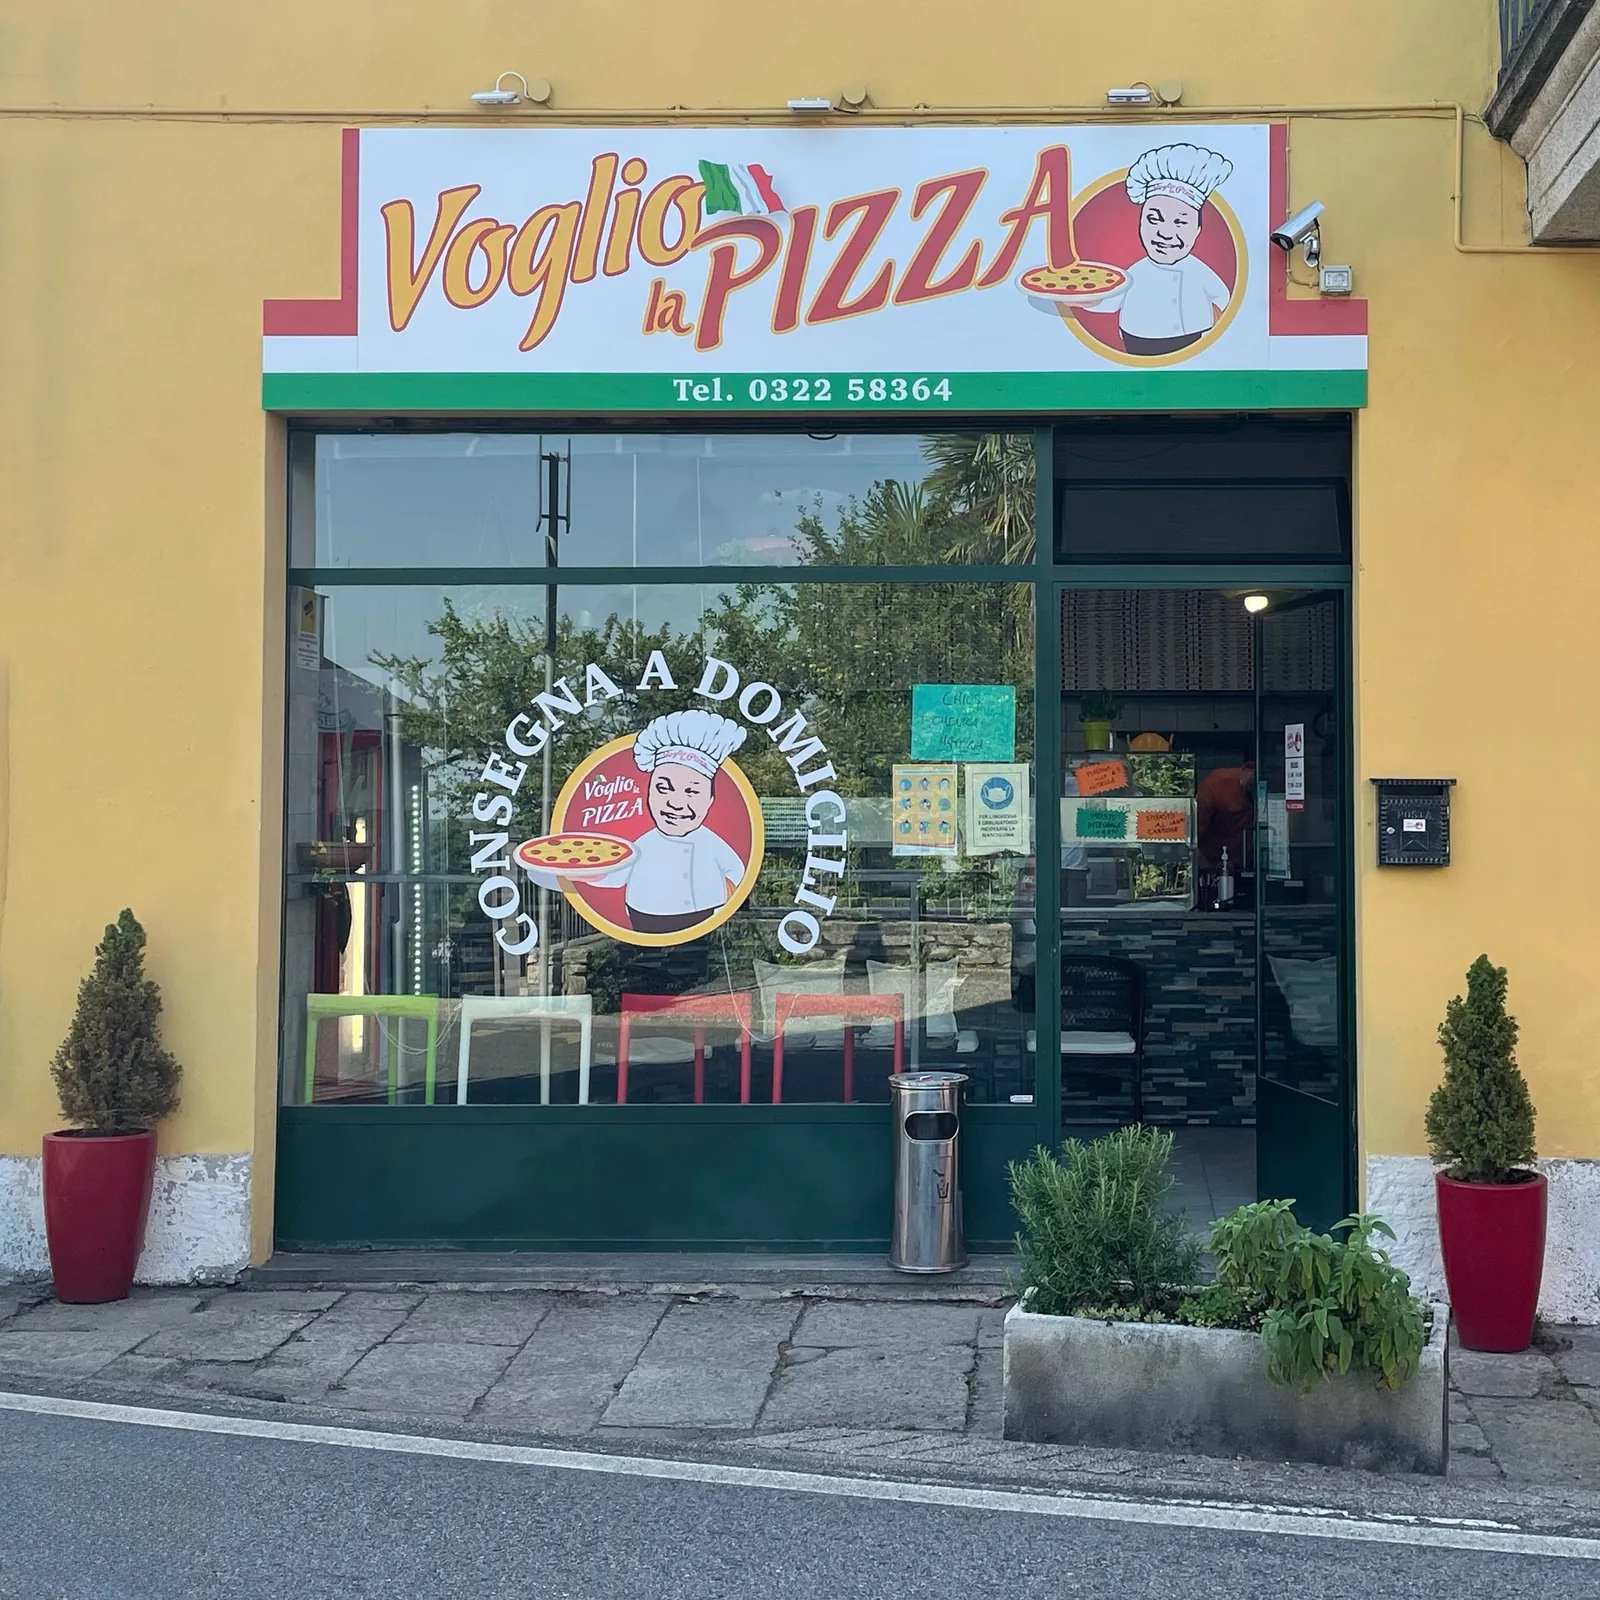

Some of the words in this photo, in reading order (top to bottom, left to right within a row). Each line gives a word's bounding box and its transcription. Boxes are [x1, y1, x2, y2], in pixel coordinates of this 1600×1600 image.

[380, 152, 707, 353] Voglio
[641, 278, 694, 337] la
[690, 143, 1081, 353] PIZZA
[672, 376, 734, 402] Tel.
[749, 377, 832, 402] 0322
[847, 377, 953, 402] 58364
[469, 661, 624, 956] CONSEGNA
[635, 649, 679, 691] A
[692, 654, 849, 955] DOMICILIO
[581, 796, 644, 828] PIZZA
[584, 775, 636, 803] Voglio
